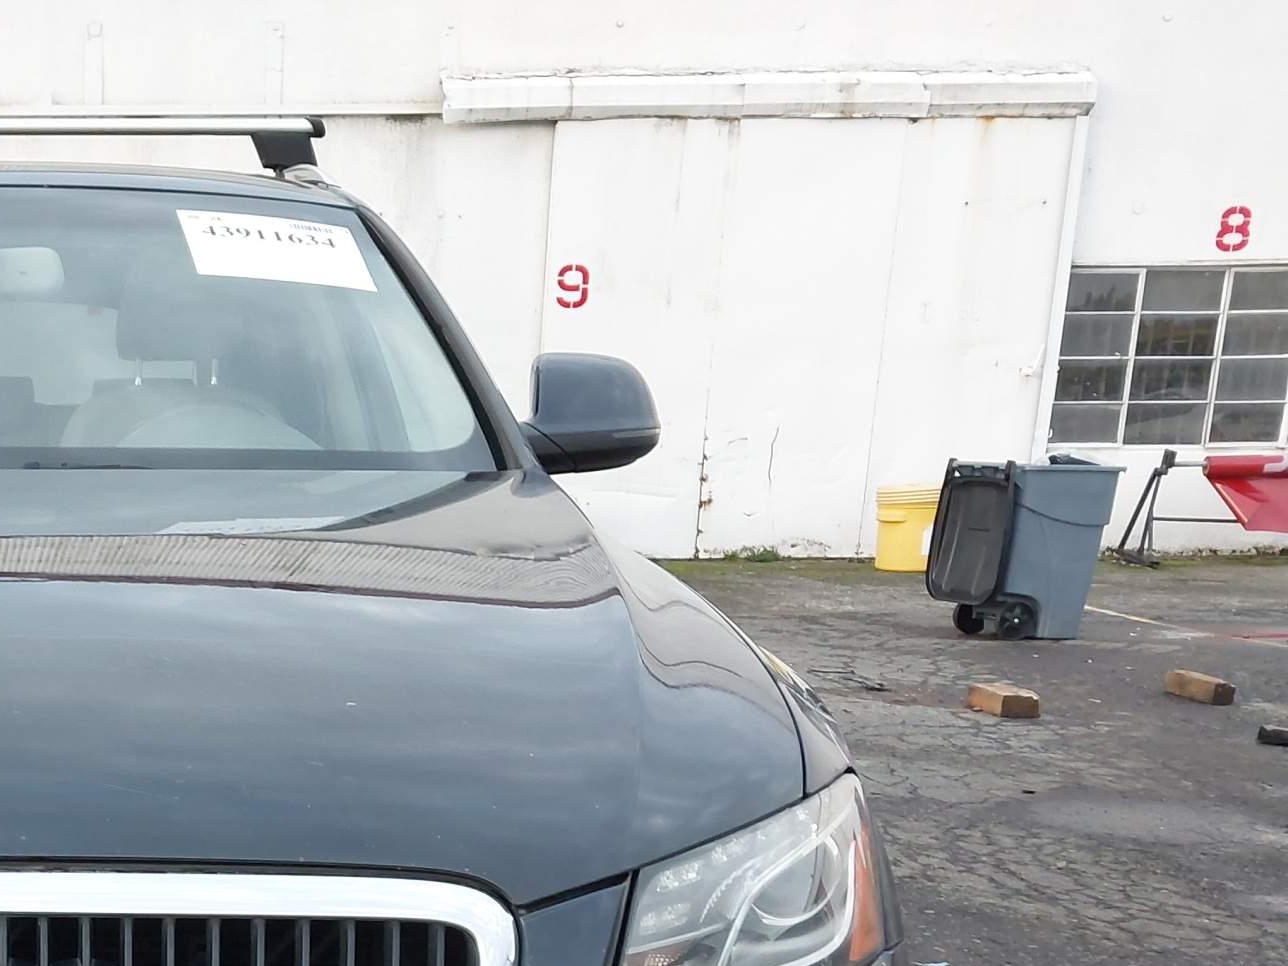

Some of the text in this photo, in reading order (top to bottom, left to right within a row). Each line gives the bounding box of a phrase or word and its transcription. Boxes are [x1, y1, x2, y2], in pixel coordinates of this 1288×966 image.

[202, 225, 336, 249] 43911634
[1215, 206, 1251, 251] 8
[556, 264, 589, 308] 9
